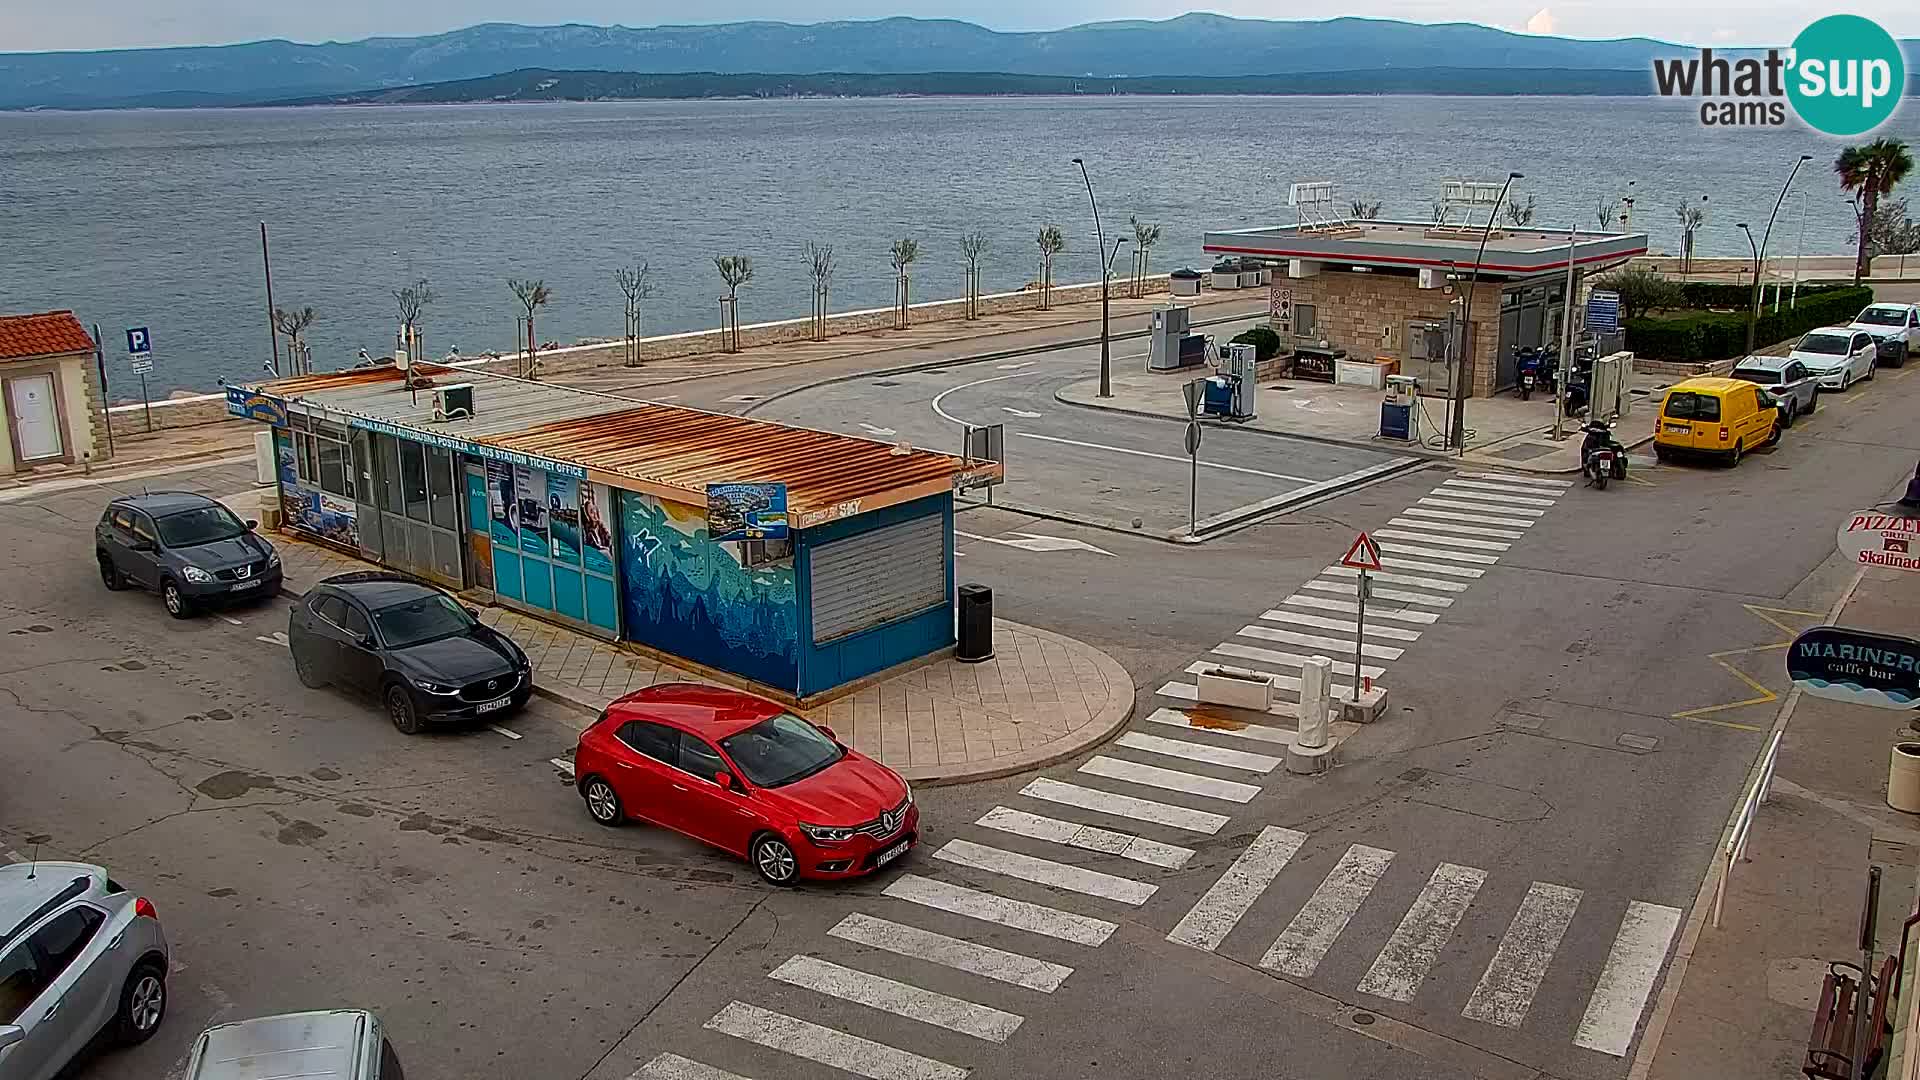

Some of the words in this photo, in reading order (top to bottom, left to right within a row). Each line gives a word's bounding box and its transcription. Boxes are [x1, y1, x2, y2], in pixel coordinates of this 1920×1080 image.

[131, 331, 145, 350] P
[397, 428, 437, 444] AUTOBUSNA
[437, 437, 469, 452] POSTAJA
[479, 446, 494, 458] BUS
[495, 450, 527, 465] STATION
[529, 457, 555, 472] TICKET
[556, 463, 583, 477] OFFICE
[1880, 530, 1916, 541] GRILL
[1827, 661, 1864, 676] caffe
[1869, 663, 1896, 681] bar
